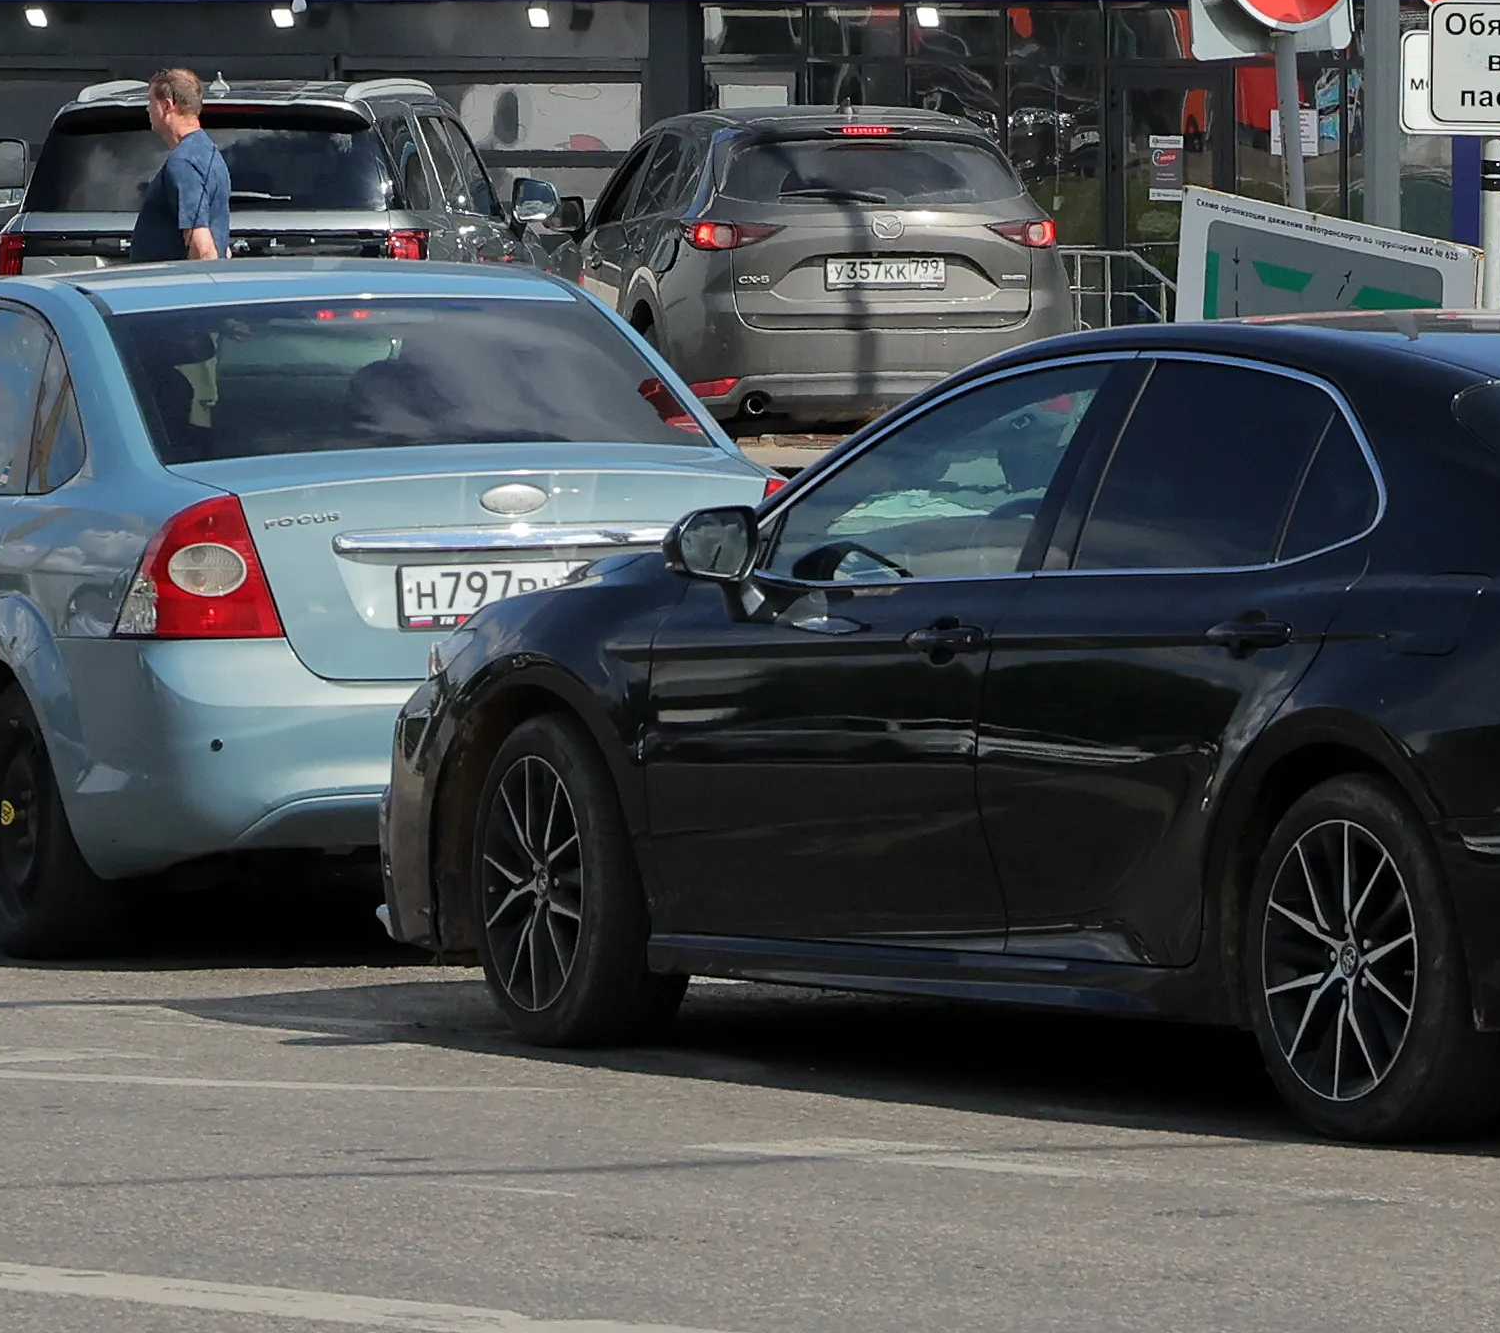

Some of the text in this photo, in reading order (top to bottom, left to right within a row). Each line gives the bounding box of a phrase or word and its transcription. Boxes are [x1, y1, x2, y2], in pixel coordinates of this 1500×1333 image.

[1196, 198, 1219, 212] Схема
[1419, 245, 1435, 257] АЗС
[1444, 250, 1459, 262] 625
[738, 275, 770, 285] CX-5
[833, 259, 939, 281] У357КК 799
[263, 511, 340, 531] FOCUS
[416, 570, 549, 610] Н797
